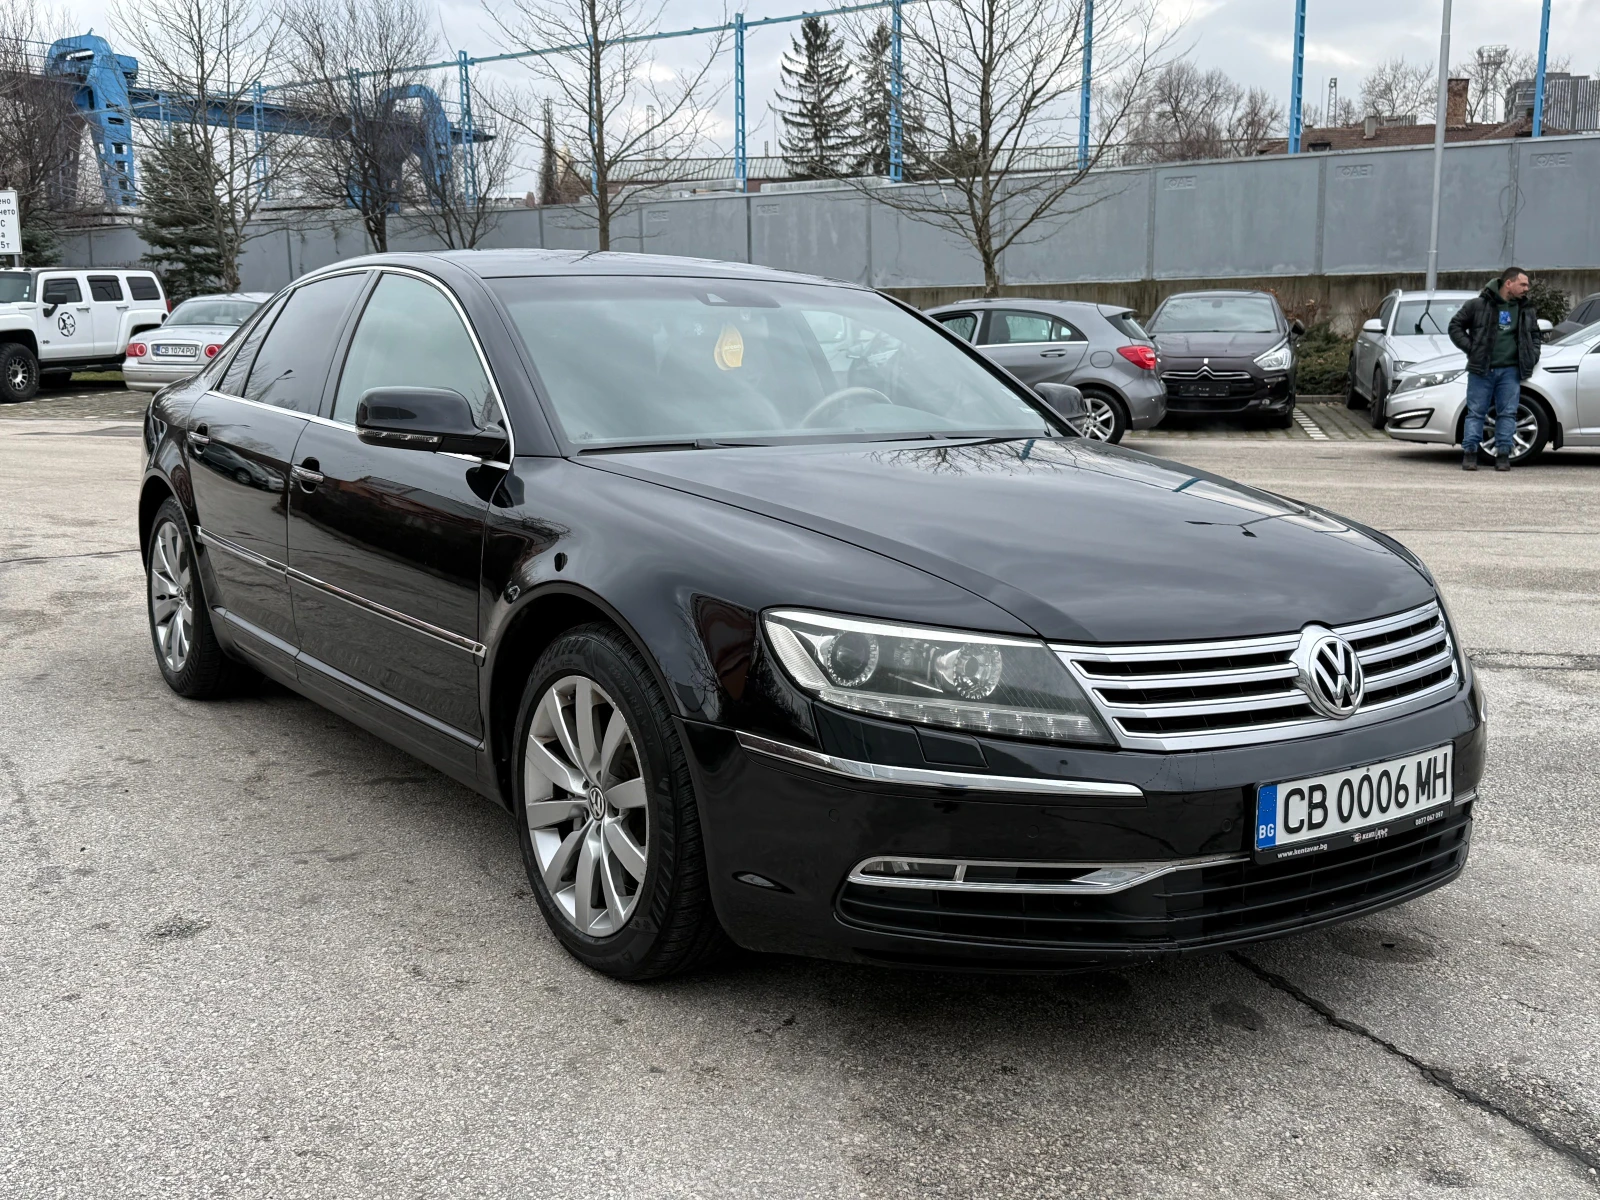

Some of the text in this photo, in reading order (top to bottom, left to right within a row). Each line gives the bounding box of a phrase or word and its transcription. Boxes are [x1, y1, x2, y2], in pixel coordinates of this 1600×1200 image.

[1310, 636, 1363, 717] VW
[1283, 752, 1448, 835] CB 0006 MH
[1259, 824, 1275, 839] BG
[1277, 843, 1328, 858] www.kentavar.bg
